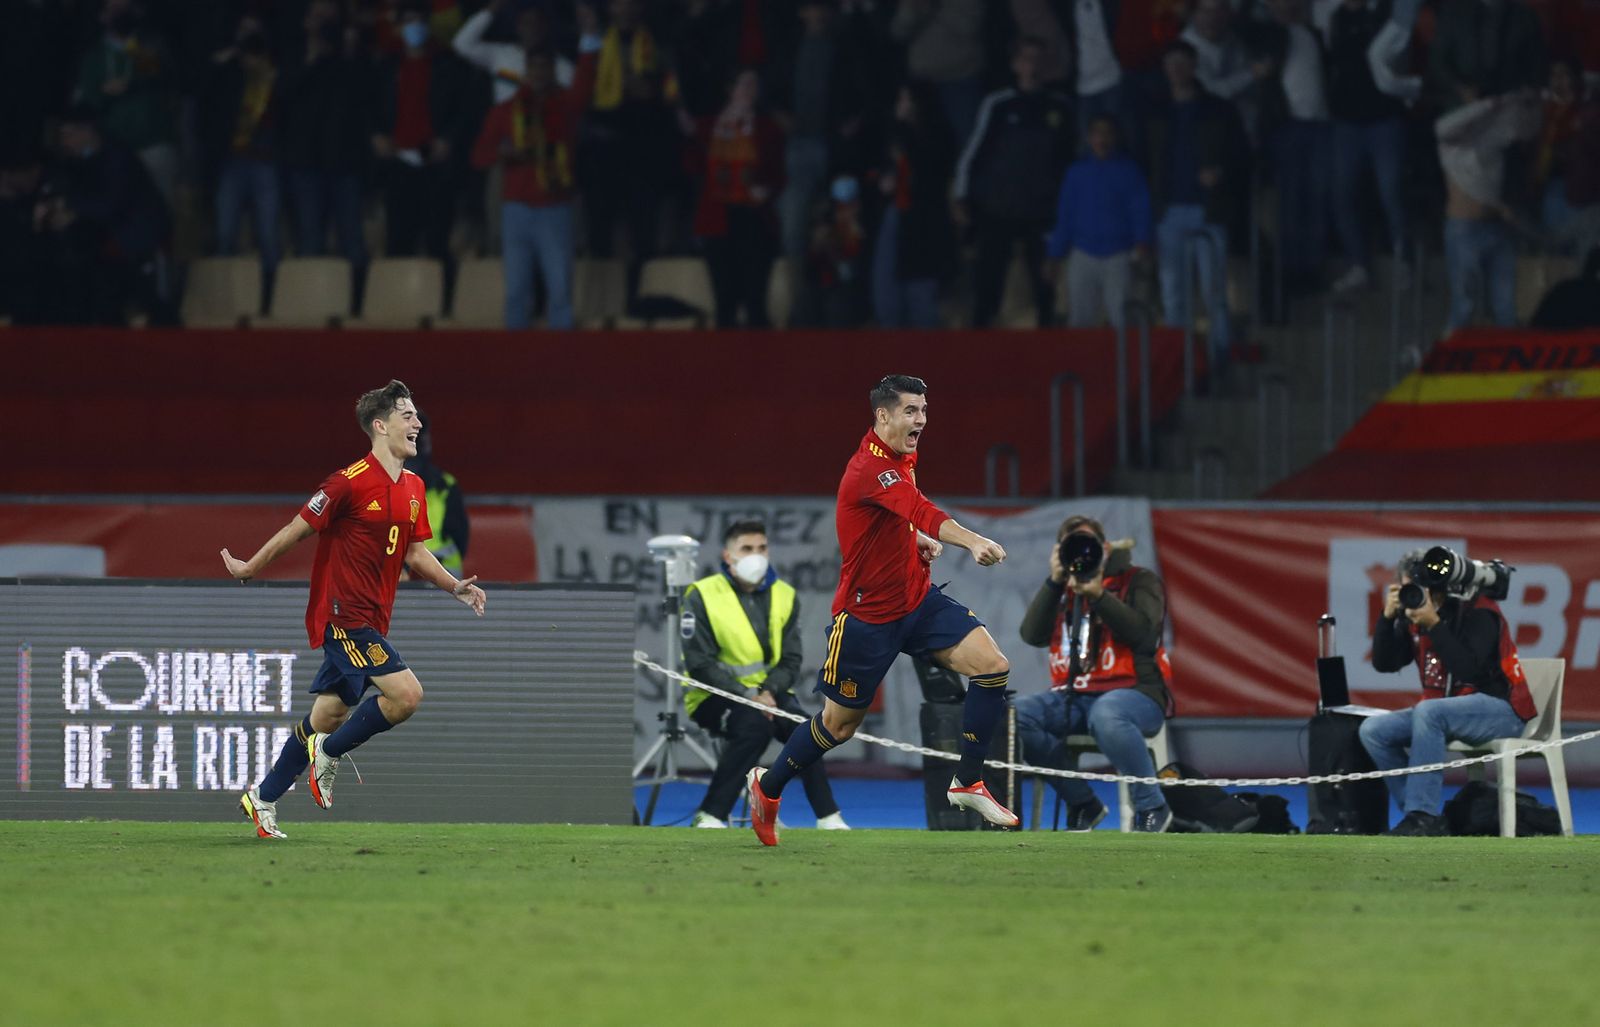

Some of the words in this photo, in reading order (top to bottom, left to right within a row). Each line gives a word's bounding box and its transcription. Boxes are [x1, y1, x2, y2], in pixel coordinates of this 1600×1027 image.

[604, 499, 660, 534] EN
[386, 525, 400, 555] 9
[553, 543, 598, 580] LA
[63, 647, 297, 713] GOURMET
[65, 725, 113, 789] DE
[131, 726, 179, 789] LA
